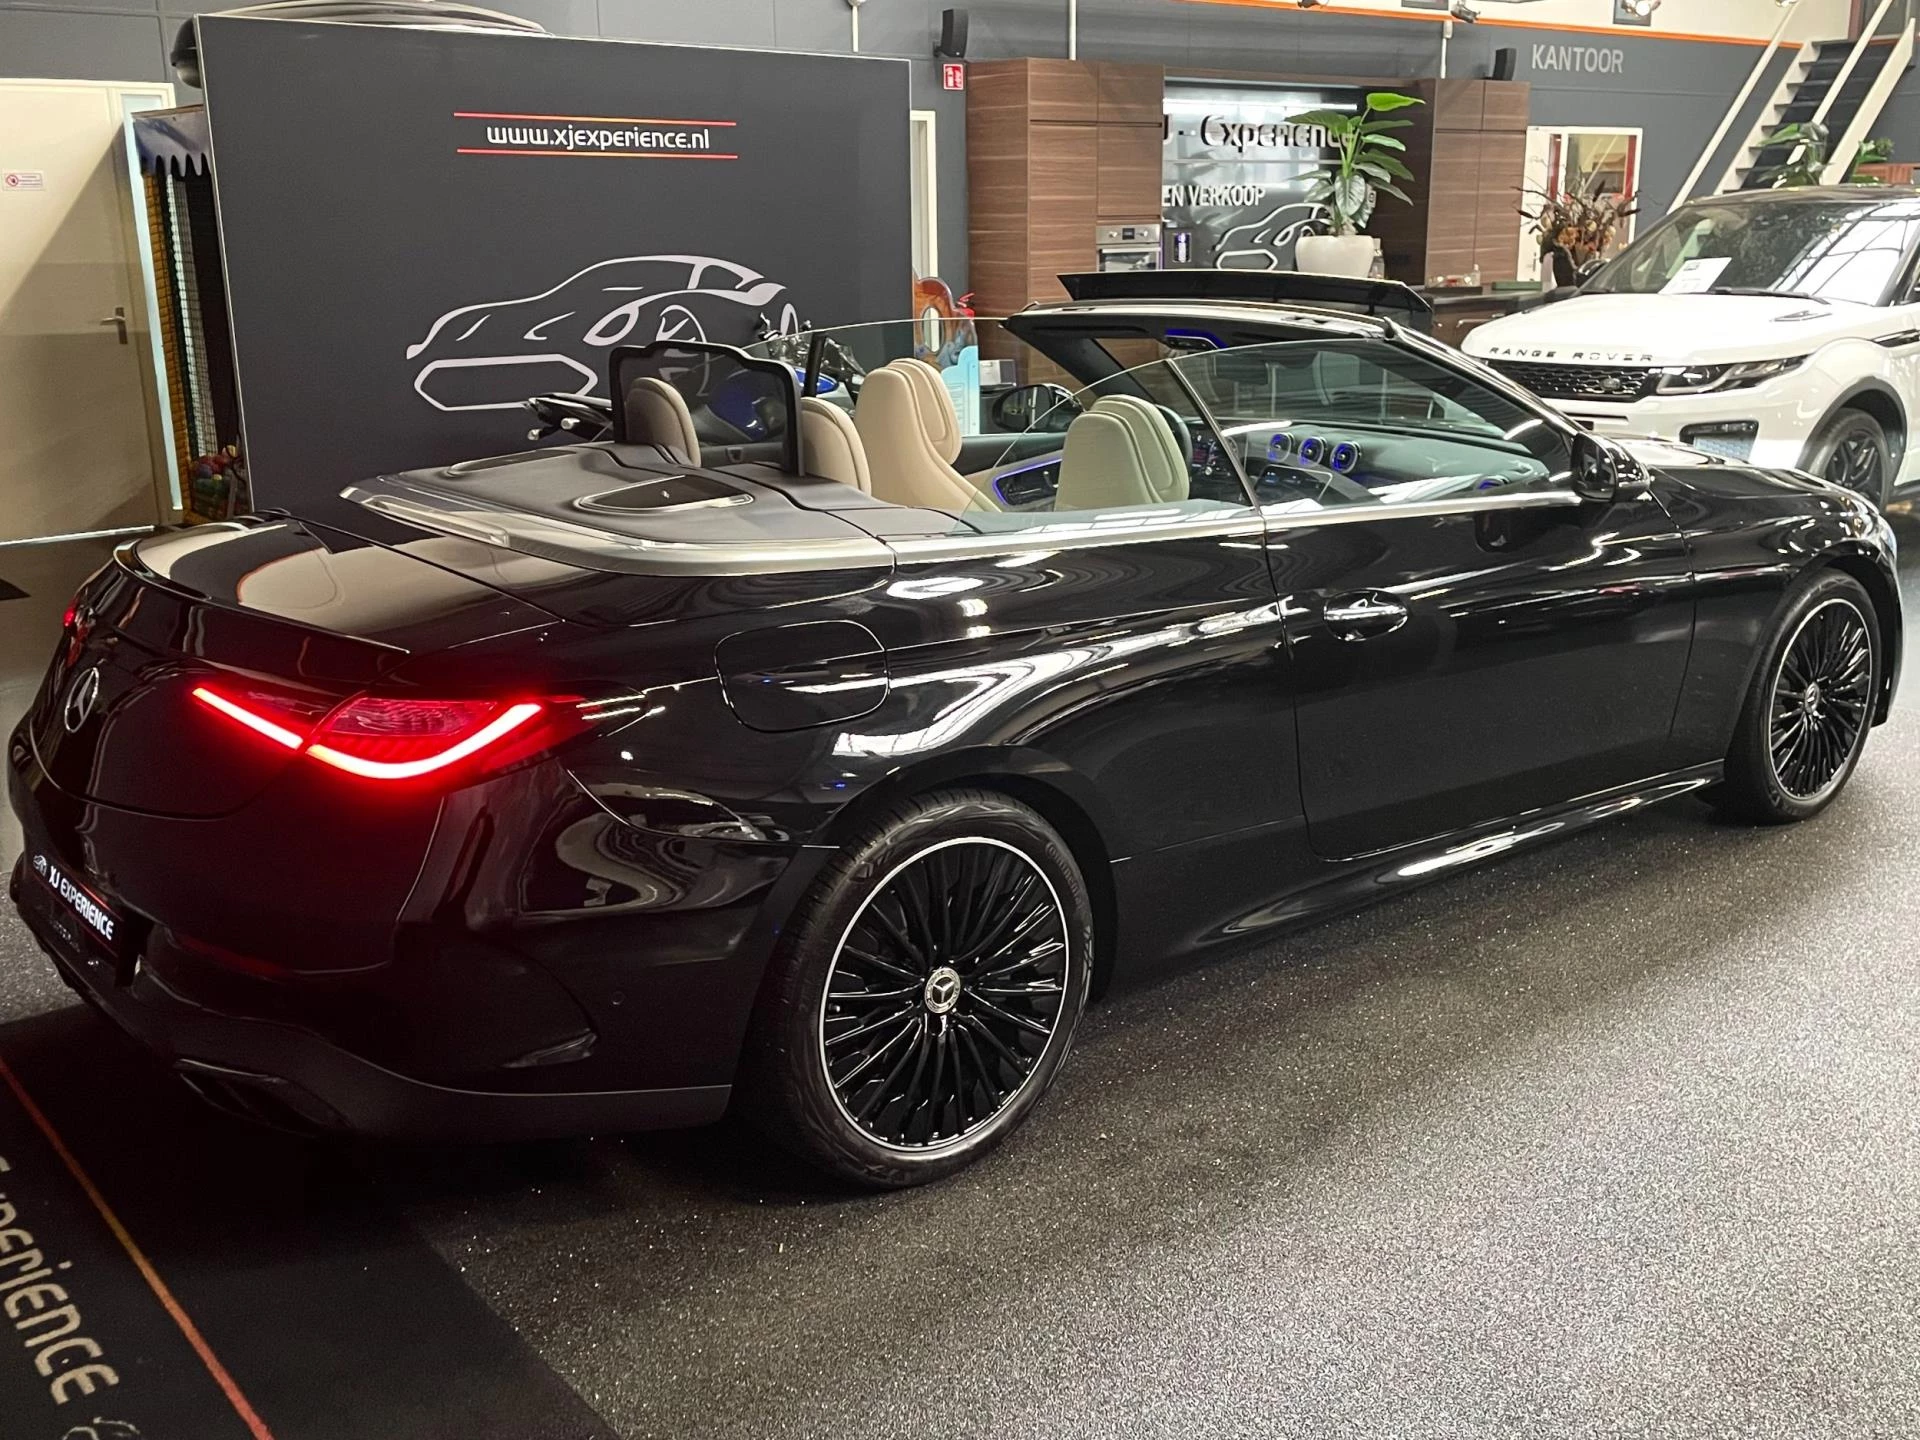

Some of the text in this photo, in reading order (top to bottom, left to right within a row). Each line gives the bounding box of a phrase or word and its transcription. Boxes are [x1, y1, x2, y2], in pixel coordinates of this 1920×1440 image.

[1531, 43, 1624, 74] KANTOOR
[486, 124, 710, 151] www.xjexperience.nl
[1188, 184, 1266, 207] VERKOOP
[1489, 346, 1653, 362] RANGE ROVER
[48, 865, 115, 941] XJ EXPERIENCE
[0, 1154, 120, 1406] erience
